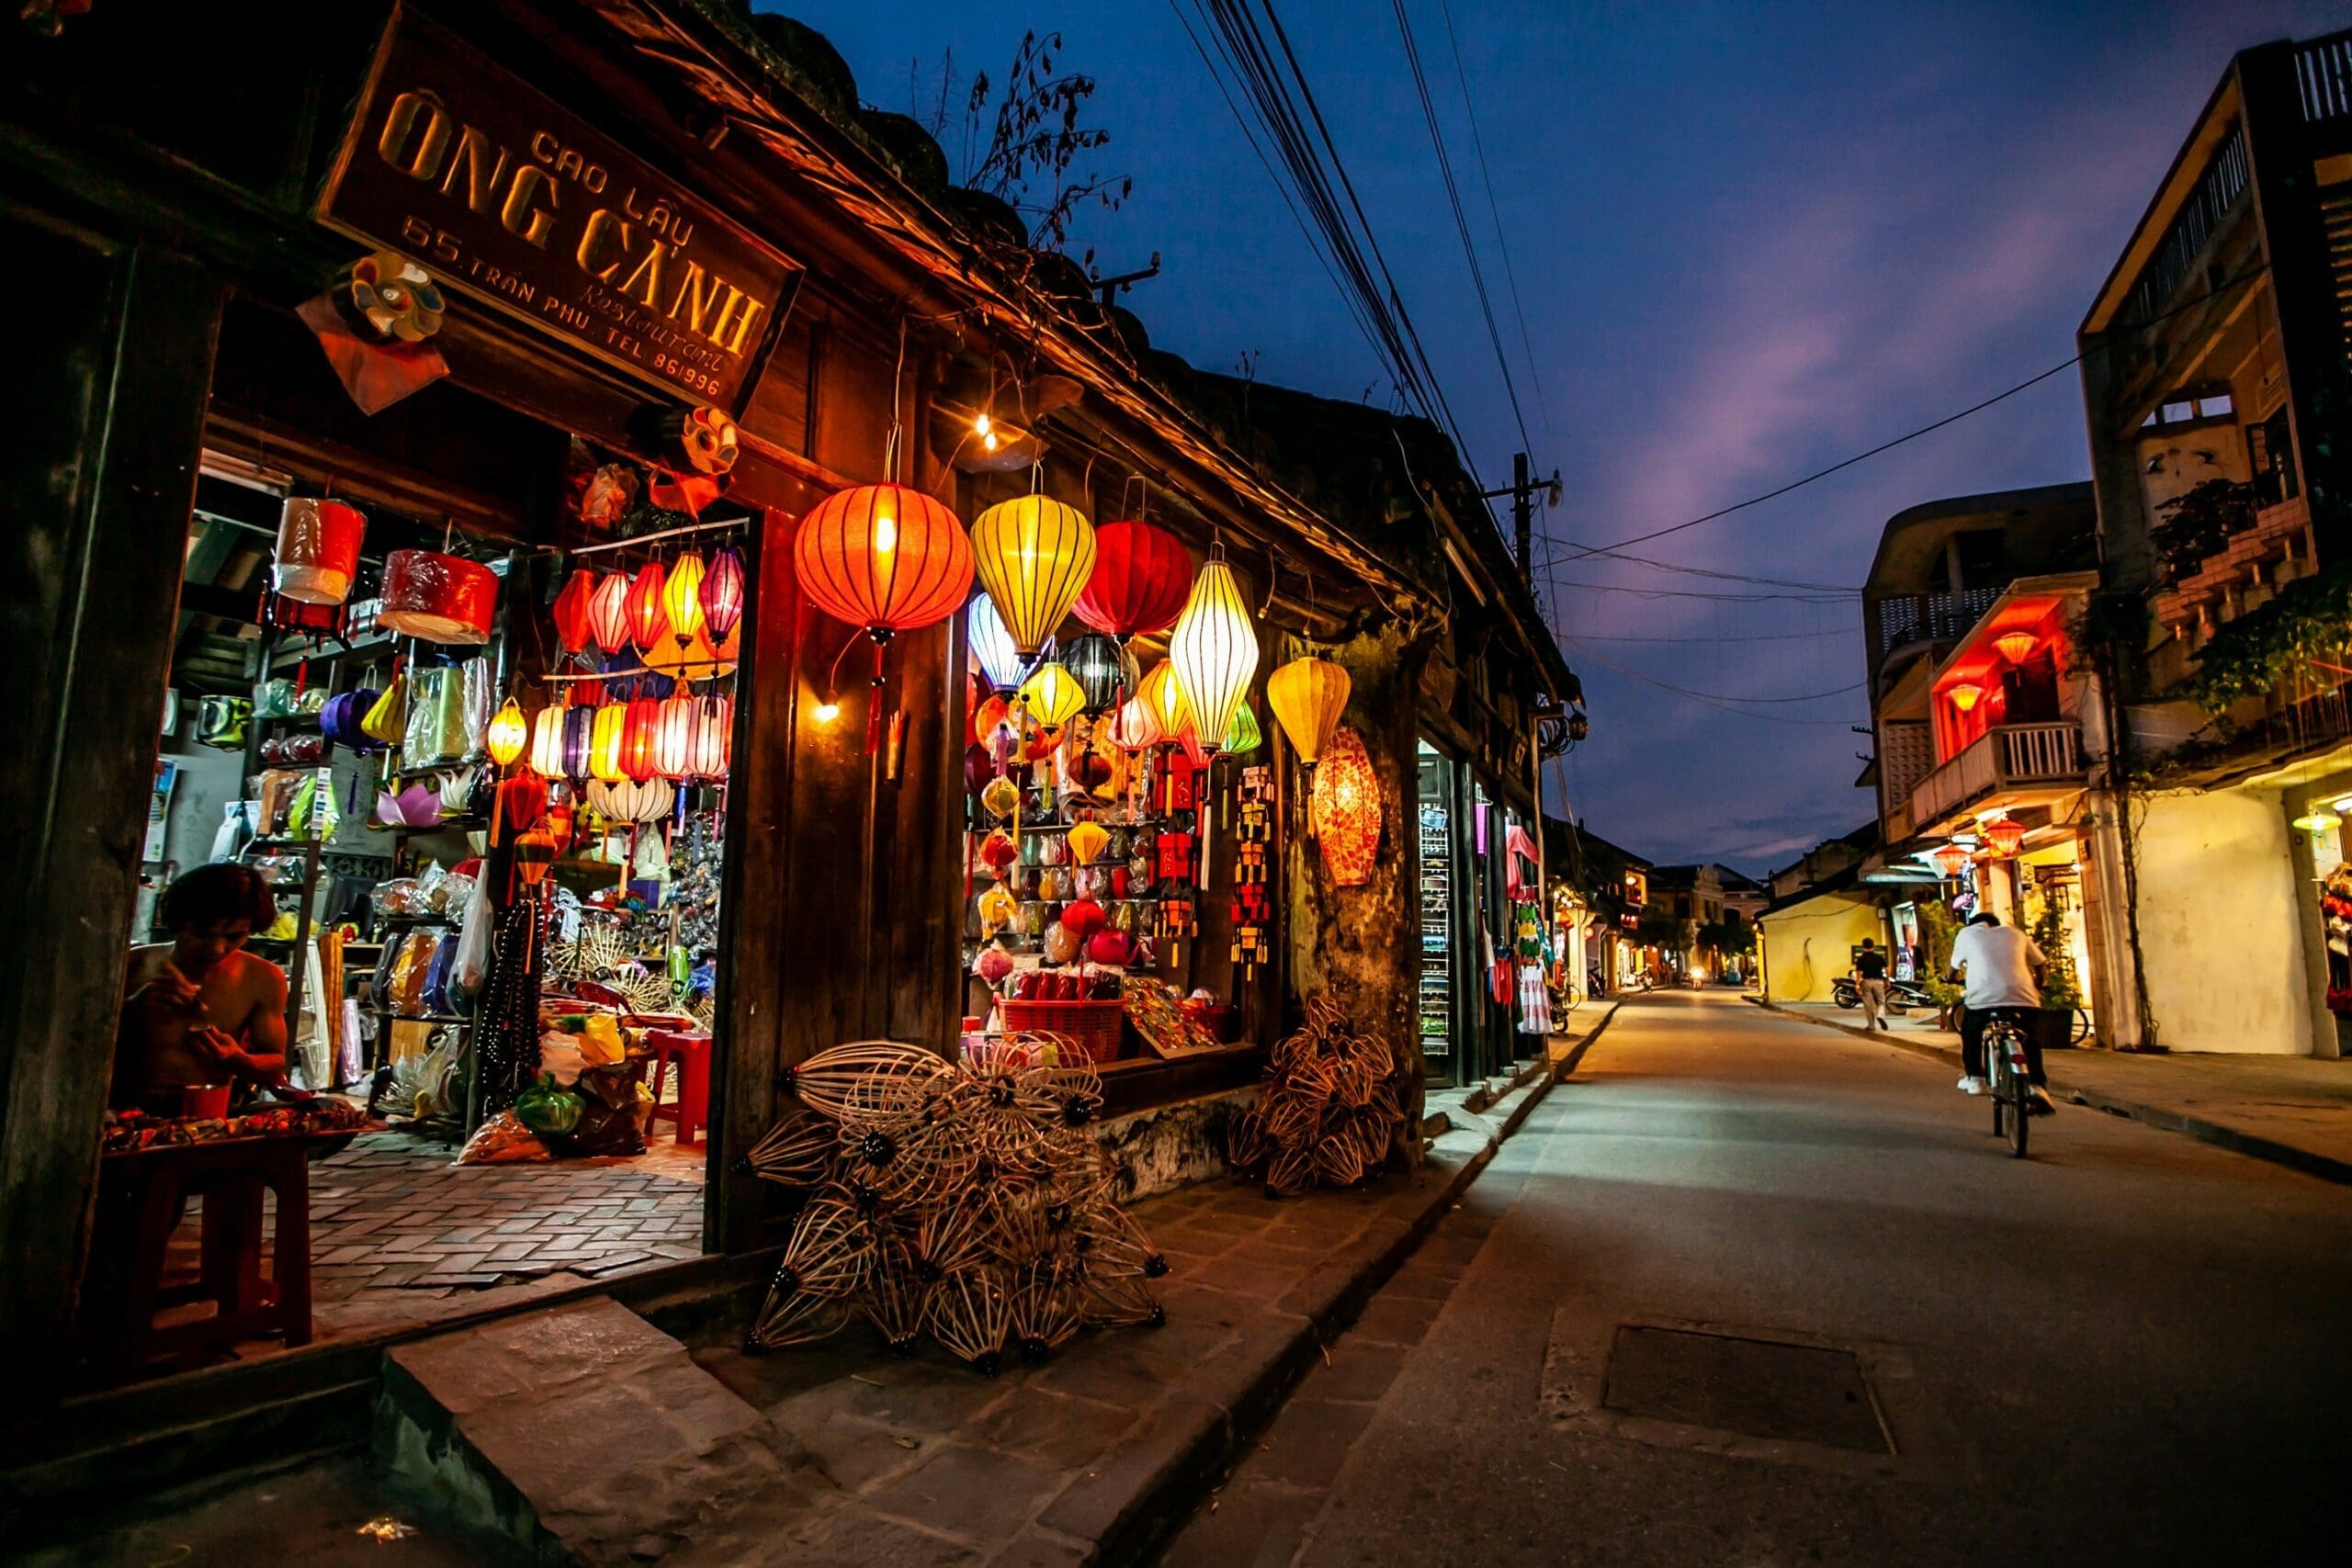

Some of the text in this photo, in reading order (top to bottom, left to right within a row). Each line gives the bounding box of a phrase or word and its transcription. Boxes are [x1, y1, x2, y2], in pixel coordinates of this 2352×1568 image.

[379, 88, 560, 251] ÔNG
[531, 130, 607, 194] CAO
[580, 284, 724, 372] Restaurant
[654, 353, 720, 396] 861996
